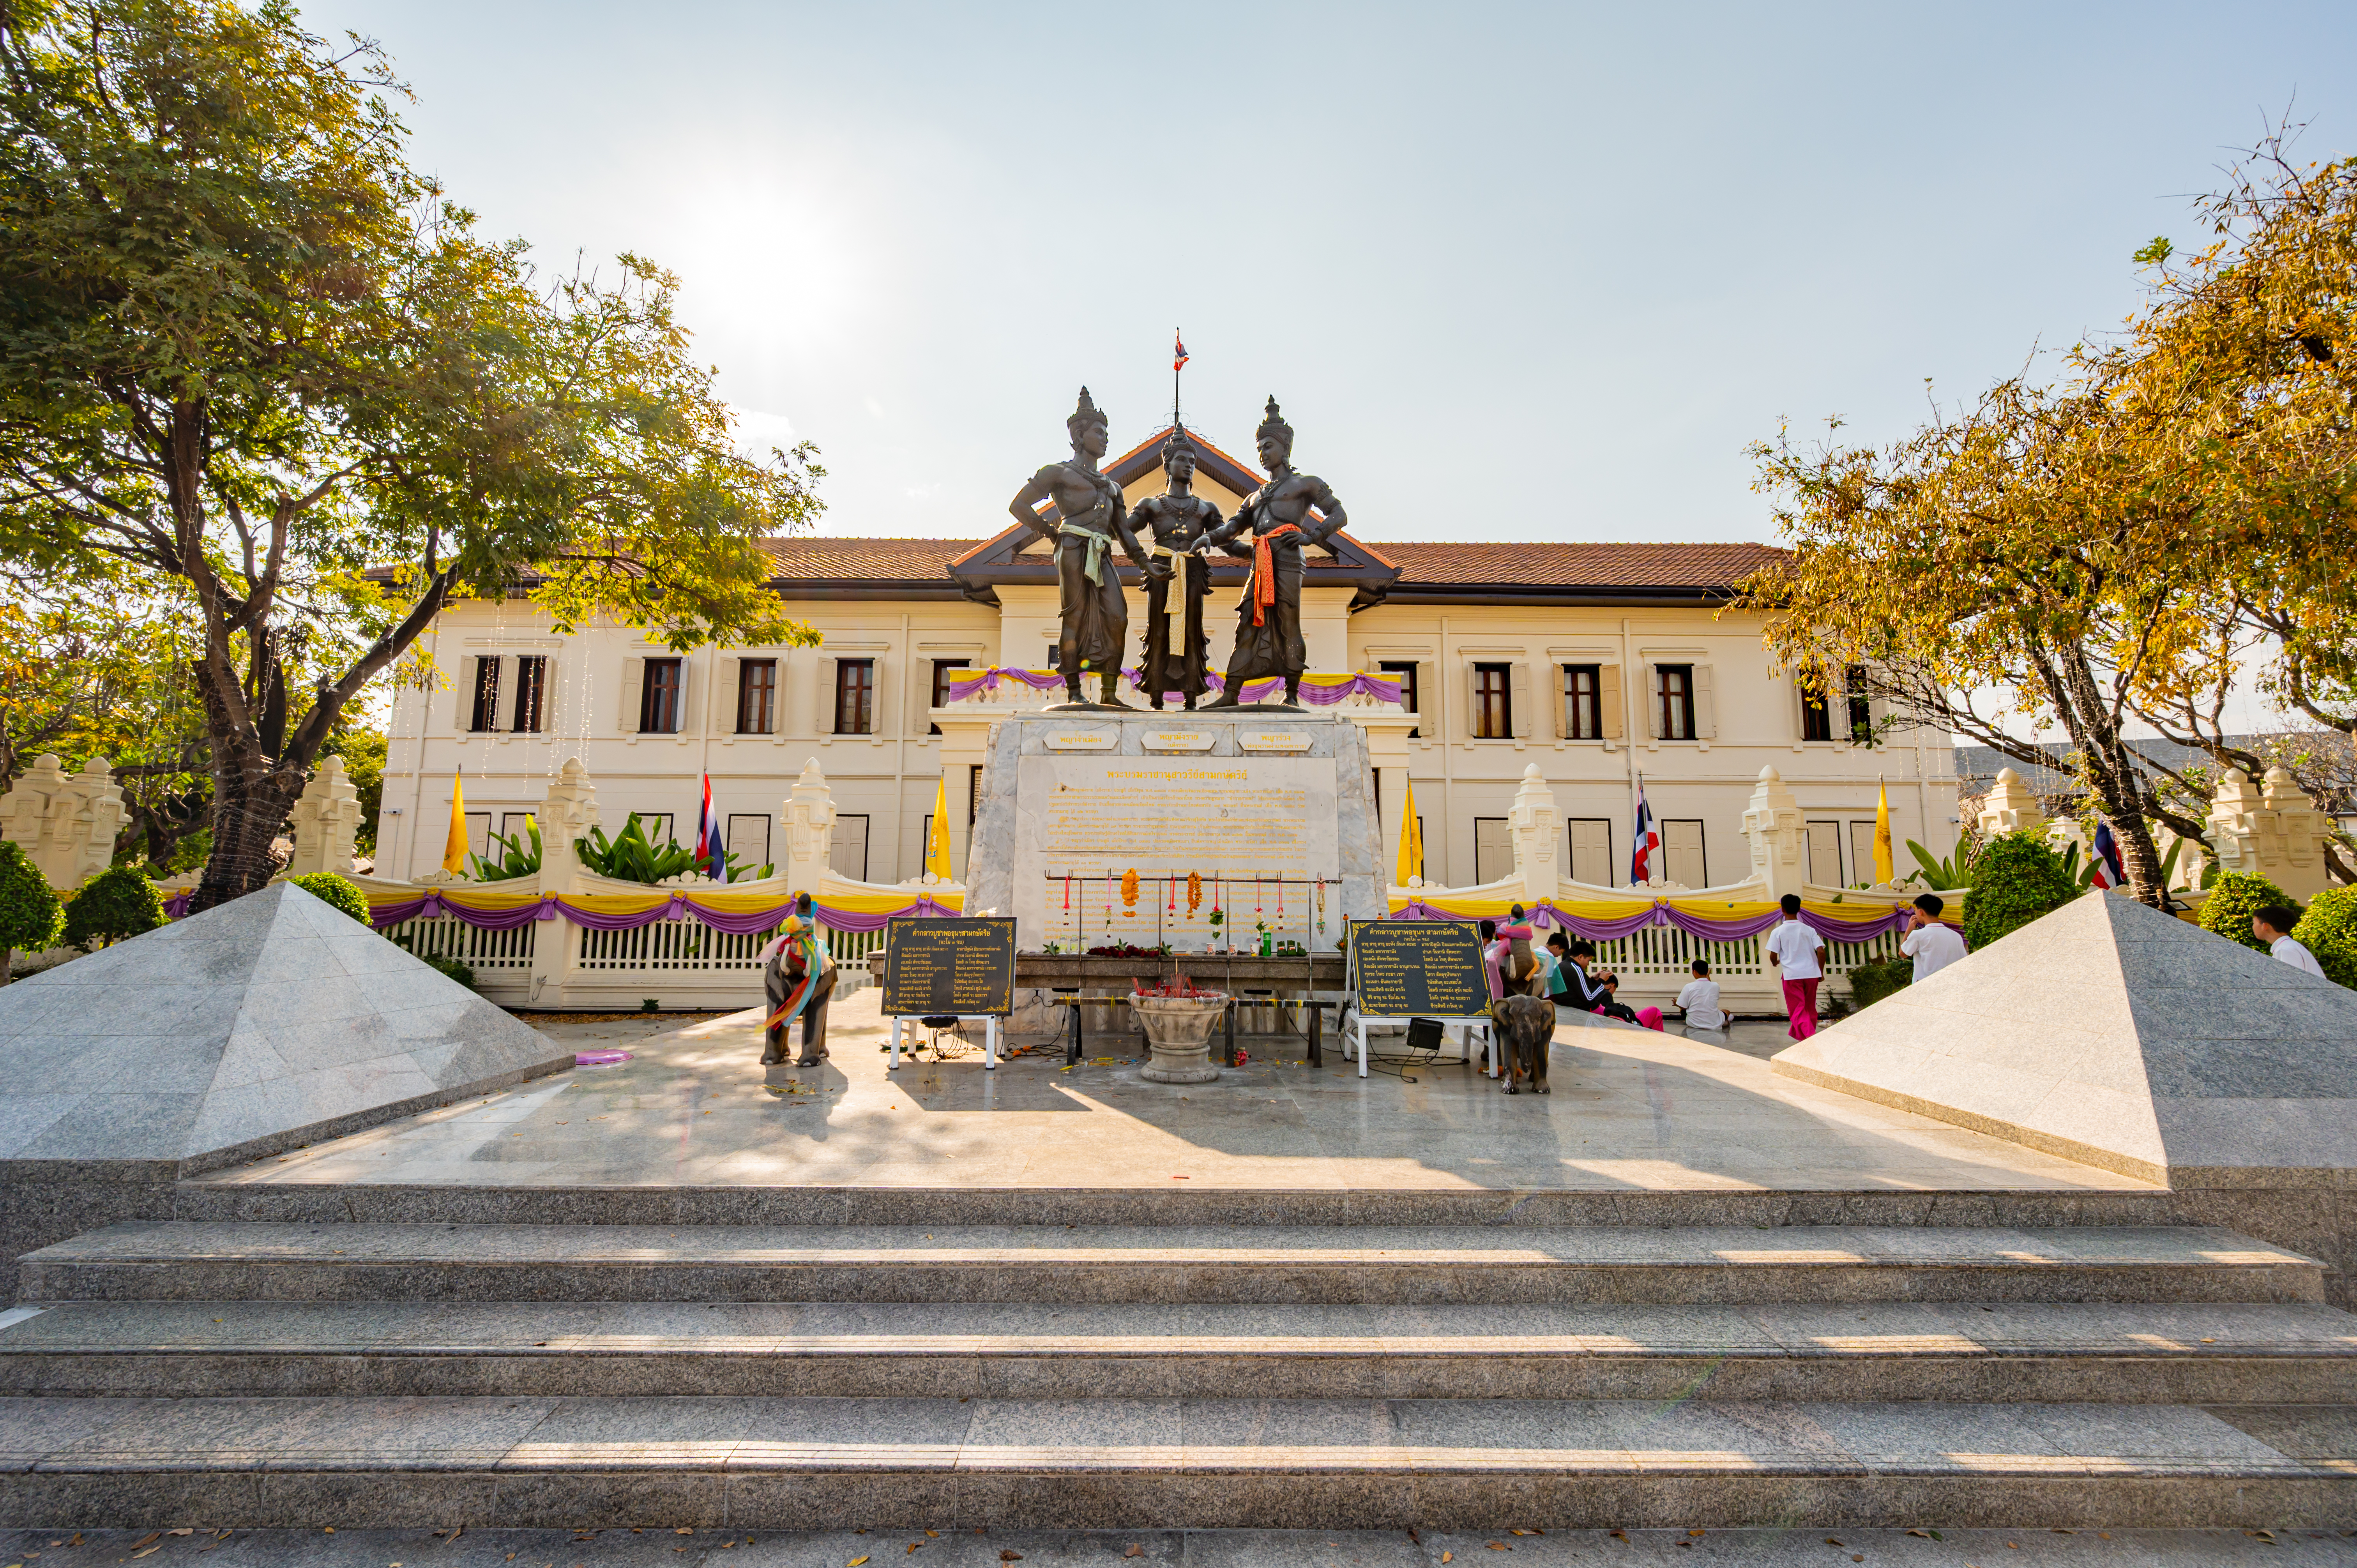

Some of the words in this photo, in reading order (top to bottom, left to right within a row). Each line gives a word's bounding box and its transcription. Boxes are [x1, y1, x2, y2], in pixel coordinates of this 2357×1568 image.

[1060, 735, 1102, 744] พญางำเมือง
[1159, 732, 1198, 742] พญามังราย
[1261, 733, 1291, 742] พญาร่วง
[1107, 768, 1247, 781] พระบรมราชานุสาวรีย์สามกษัตริย์
[913, 926, 991, 939] คำกล่าวบูชาพ่อขุนฯสามกษัตริย์
[1369, 927, 1424, 938] คำกล่าวบูชาพ่อขุนฯ
